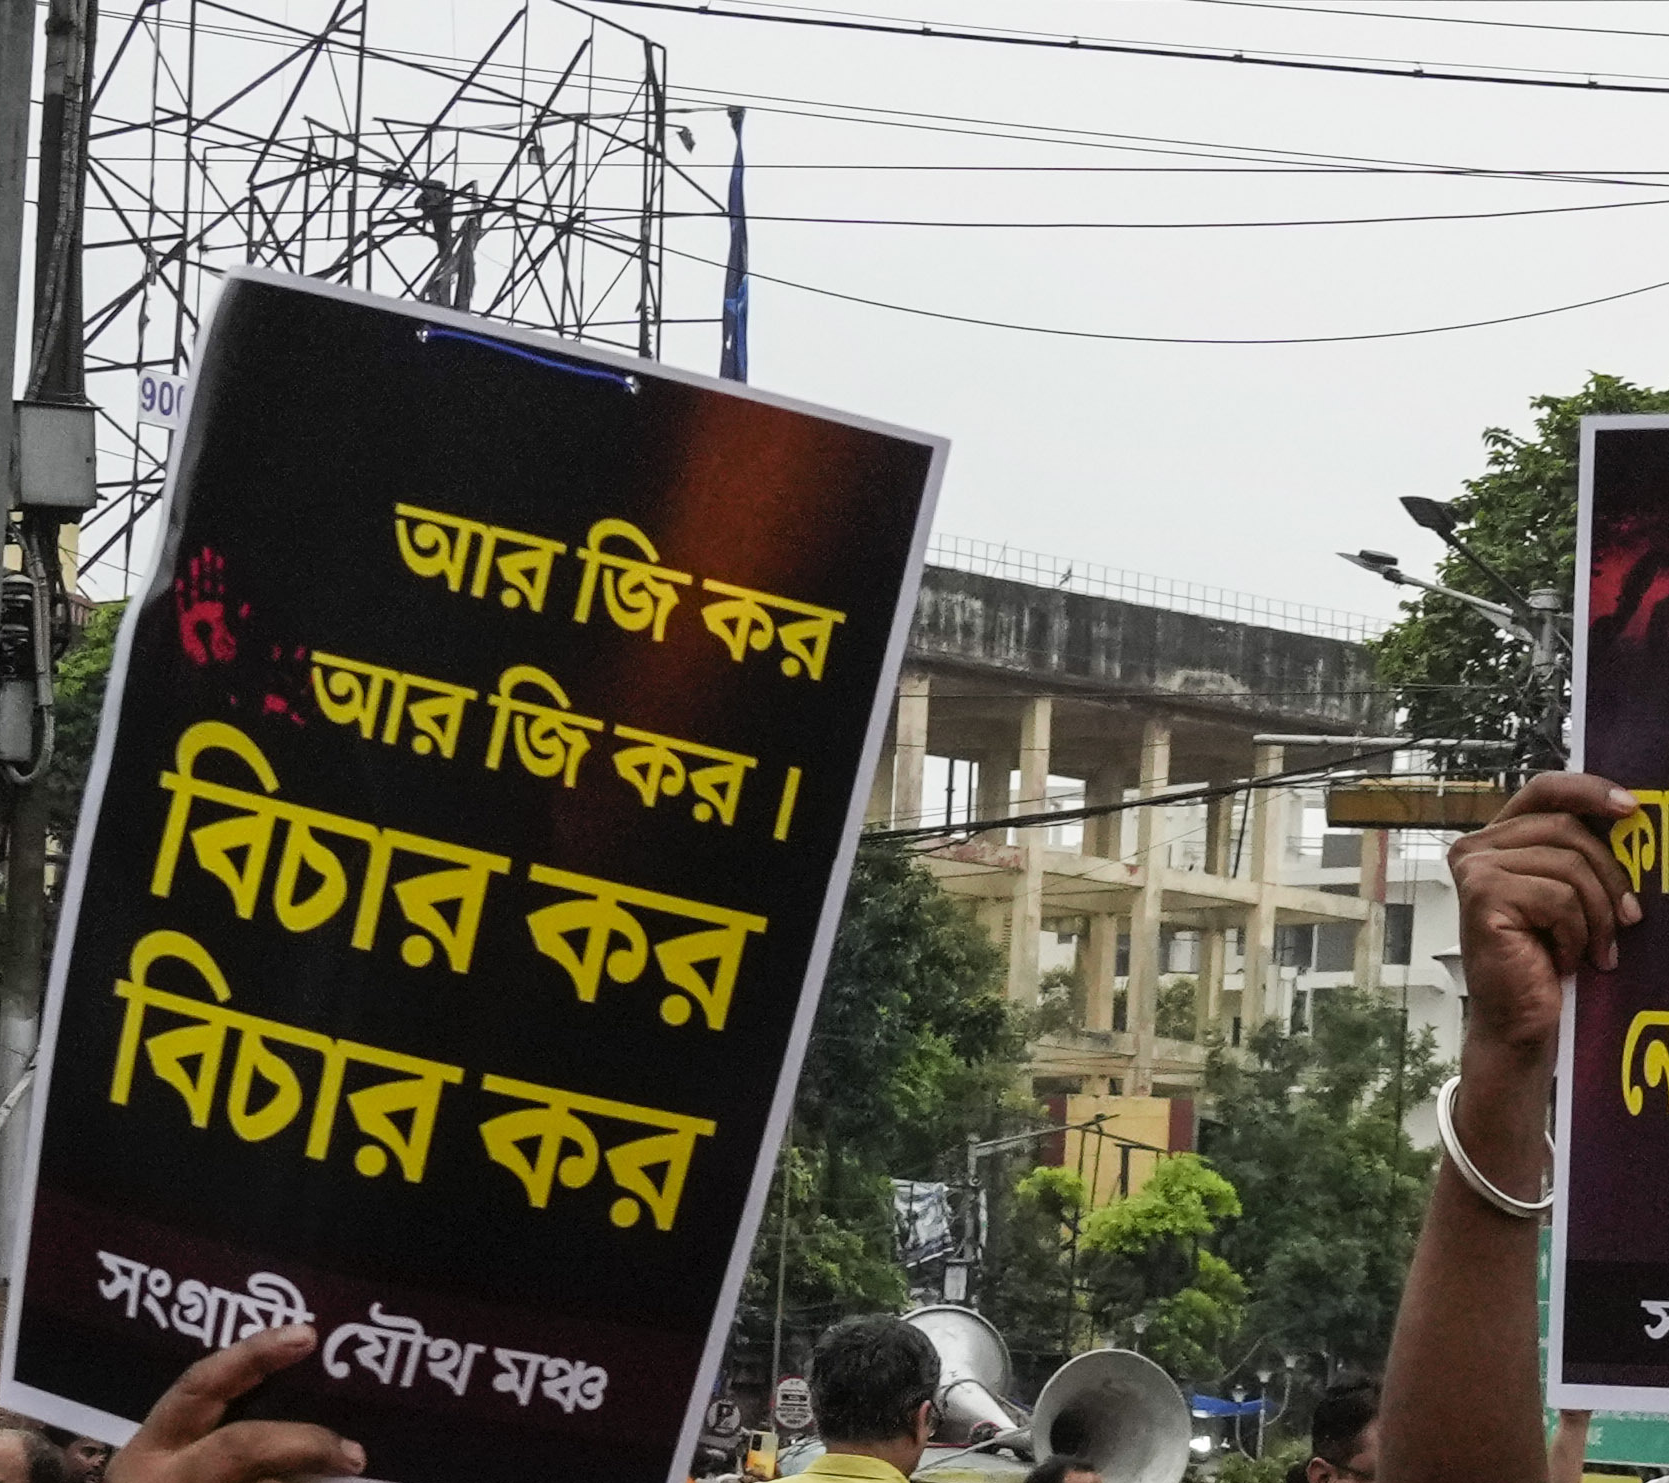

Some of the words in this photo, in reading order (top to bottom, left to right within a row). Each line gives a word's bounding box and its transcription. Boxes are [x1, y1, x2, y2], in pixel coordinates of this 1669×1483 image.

[395, 502, 567, 613] আর
[575, 518, 693, 642] জি
[701, 578, 848, 682] কর
[309, 650, 478, 759] আর
[485, 664, 604, 788] জি
[150, 720, 511, 974] বিচার
[525, 862, 767, 1031] কর
[109, 930, 464, 1183] বিচার
[479, 1073, 717, 1232] কর
[322, 1303, 483, 1397] যৌথ
[491, 1348, 609, 1413] মঞ্চ
